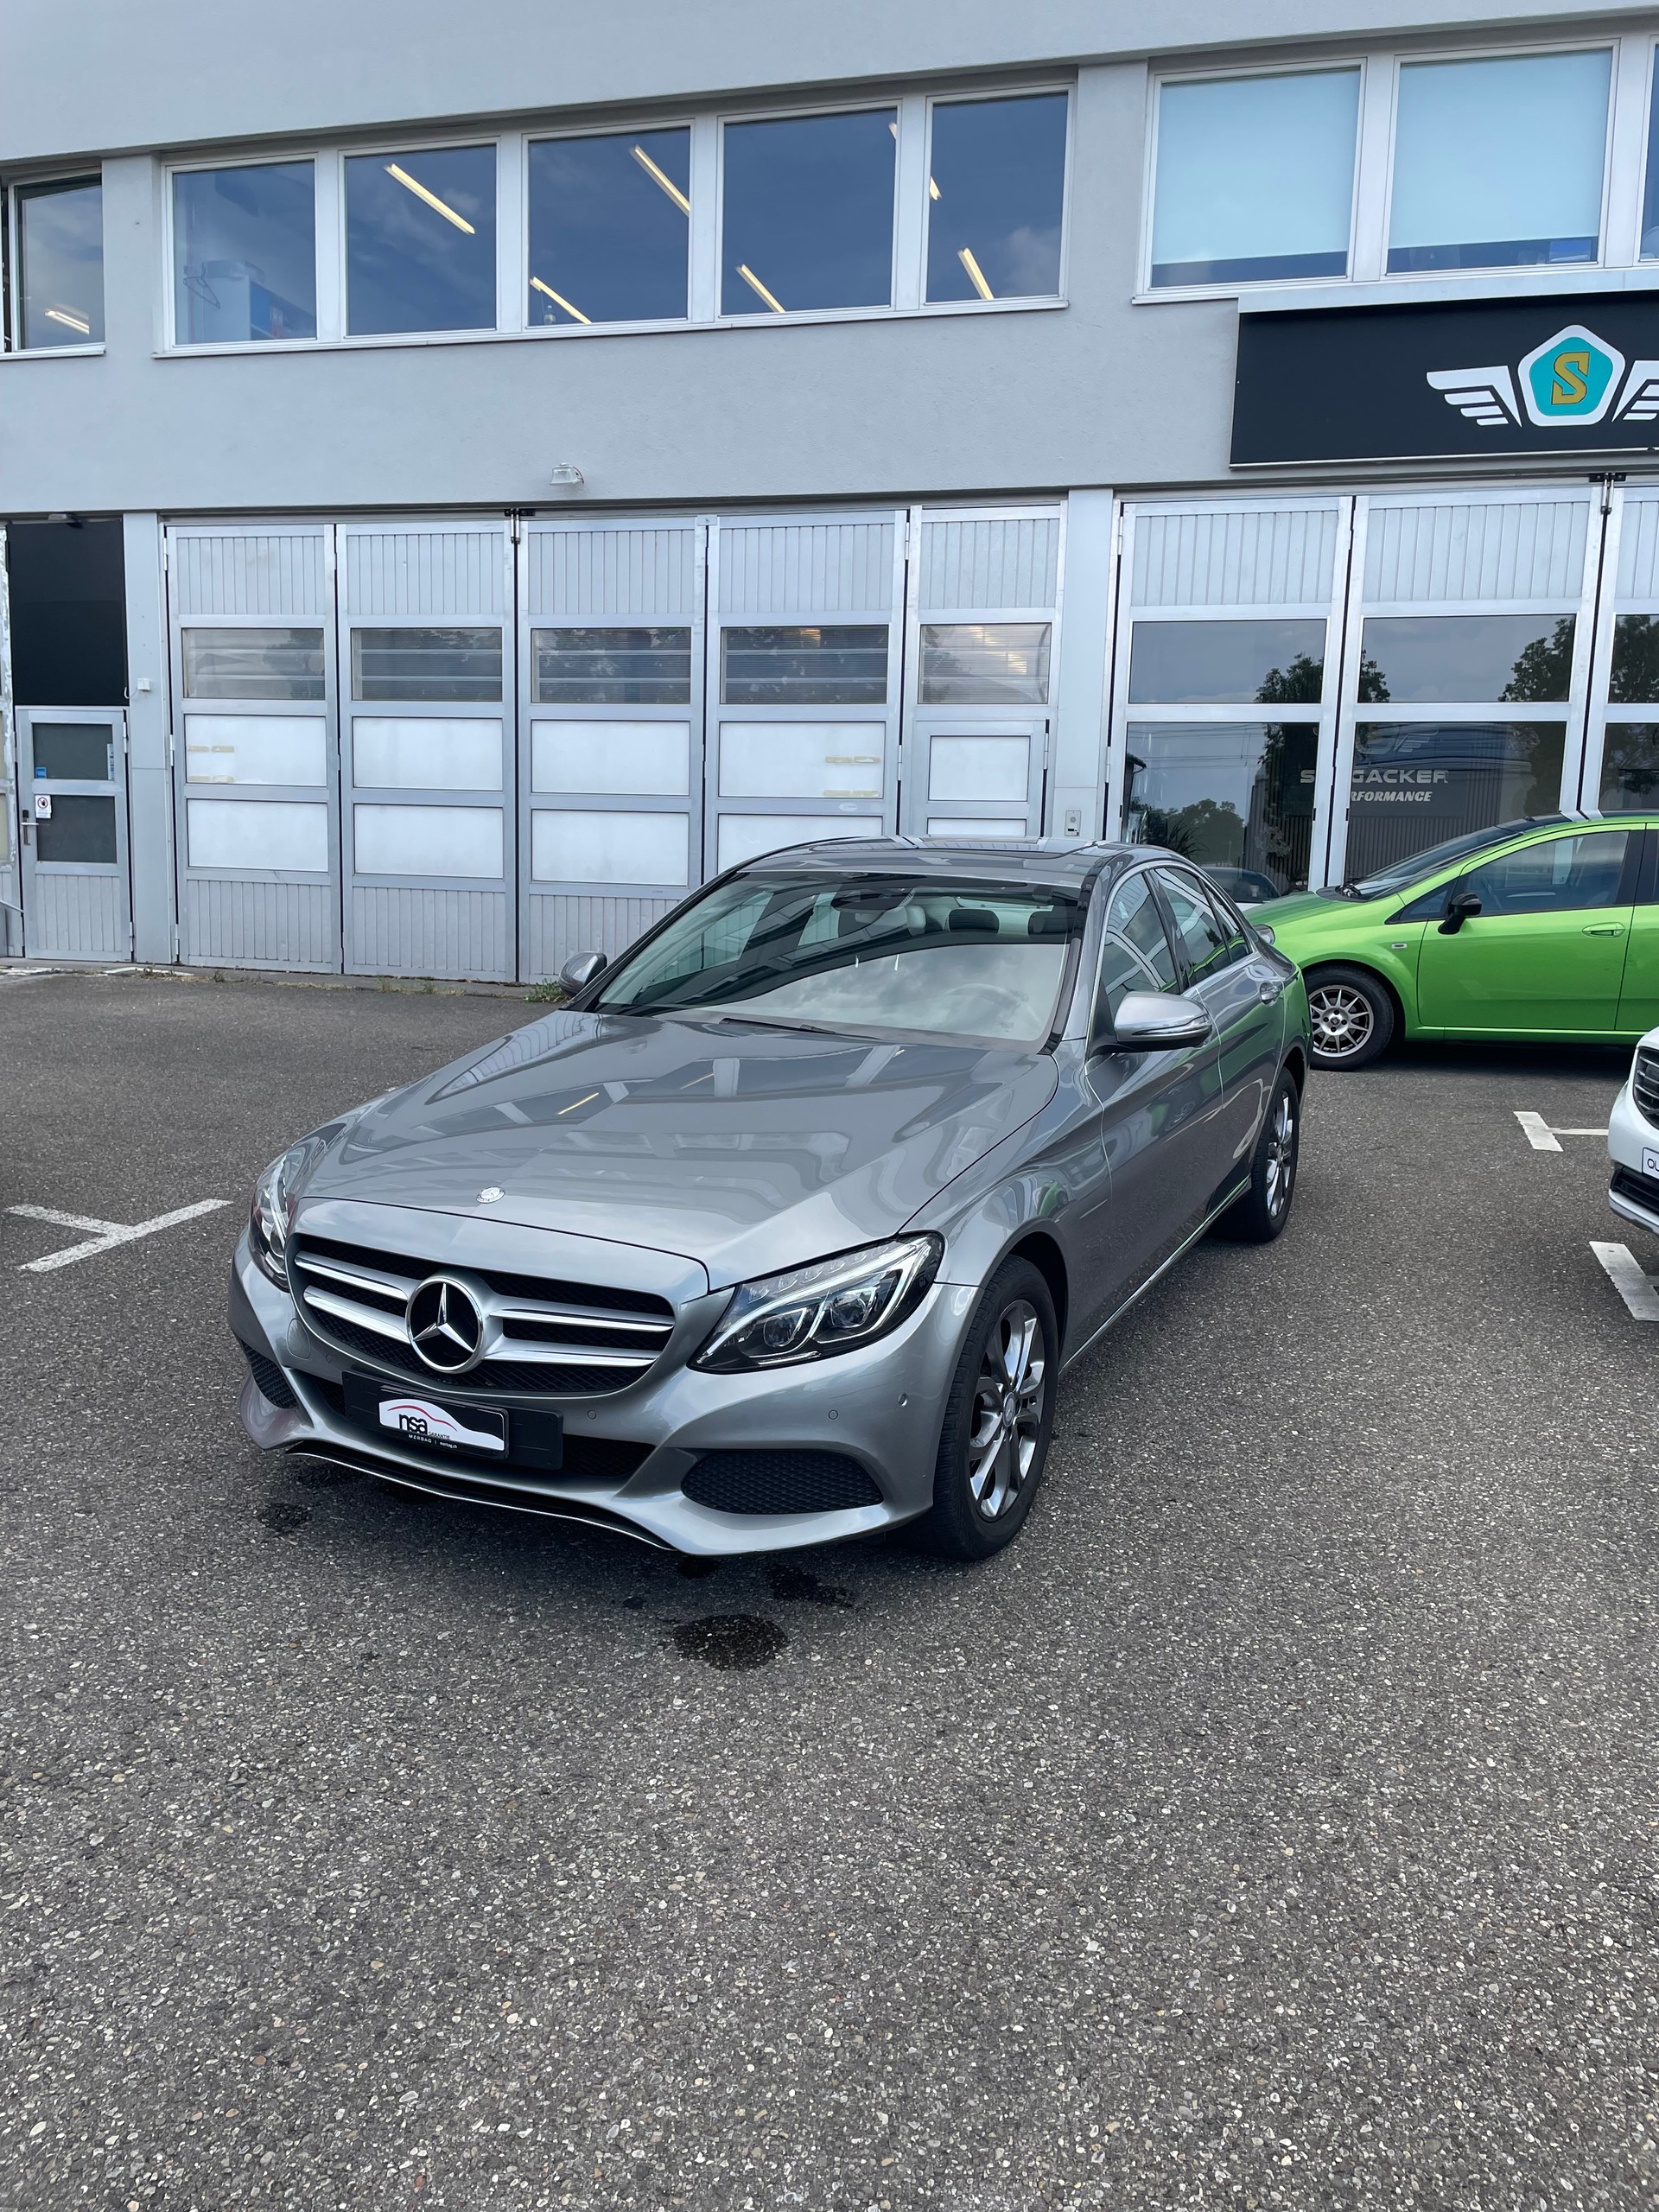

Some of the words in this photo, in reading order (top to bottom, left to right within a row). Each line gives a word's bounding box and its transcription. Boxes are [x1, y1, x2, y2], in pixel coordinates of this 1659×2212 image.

[1551, 351, 1591, 405] S
[398, 1414, 428, 1434] nsa
[409, 1434, 431, 1443] MERBAG
